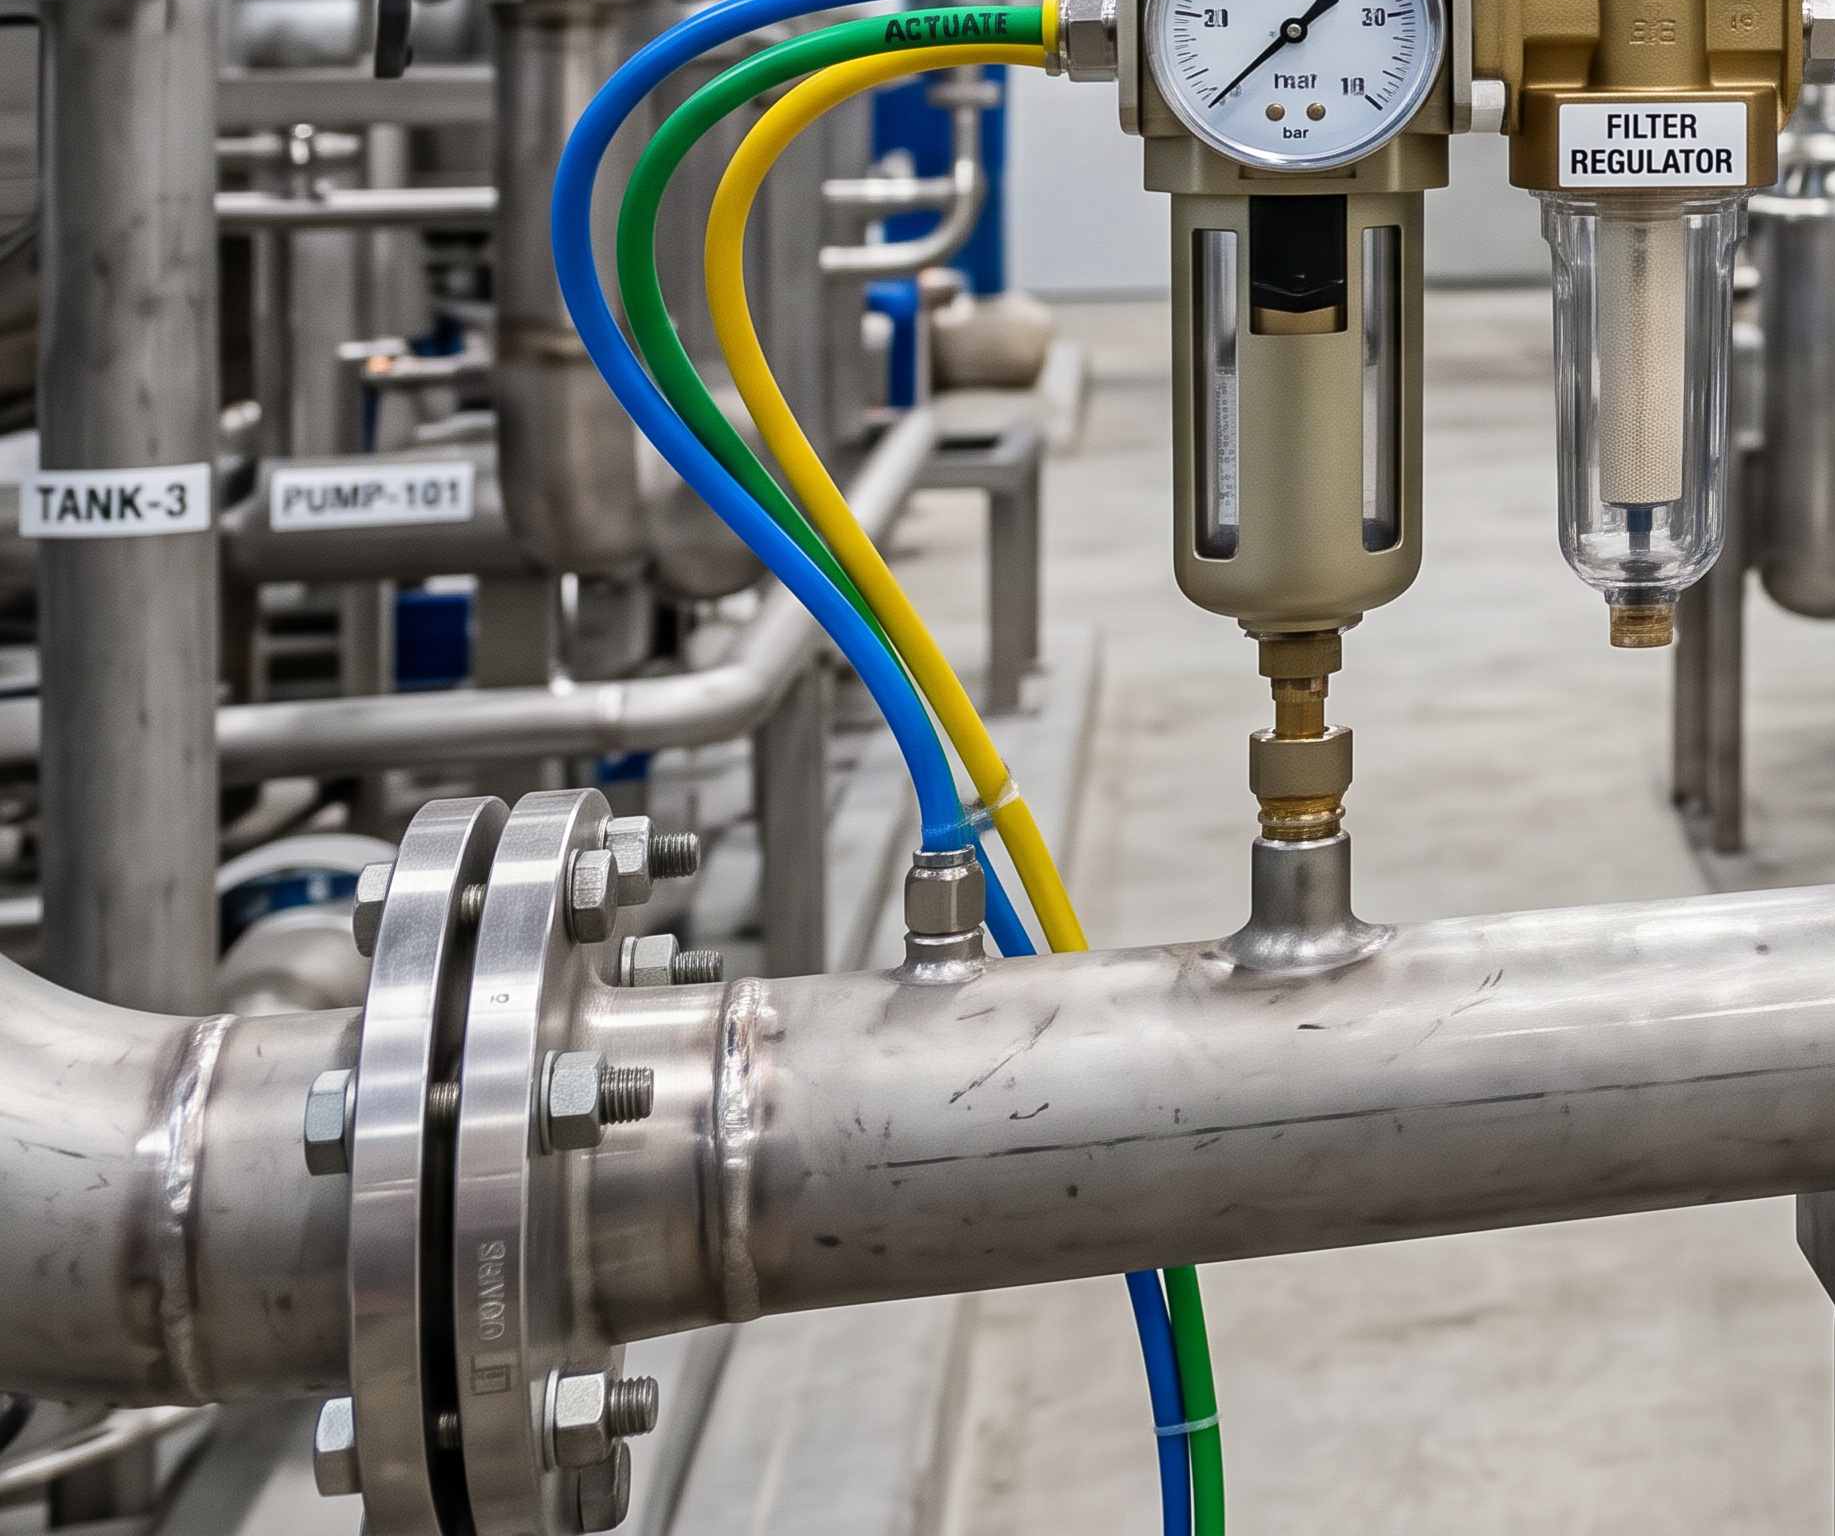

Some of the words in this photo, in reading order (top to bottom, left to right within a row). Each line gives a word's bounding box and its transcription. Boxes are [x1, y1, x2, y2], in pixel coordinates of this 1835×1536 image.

[884, 12, 1009, 44] ACTUATE
[1283, 127, 1309, 140] bar
[1607, 113, 1697, 139] FILTER
[1571, 149, 1733, 175] REGULATOR
[37, 483, 188, 521] TANK-3
[283, 479, 461, 516] PUMP-101
